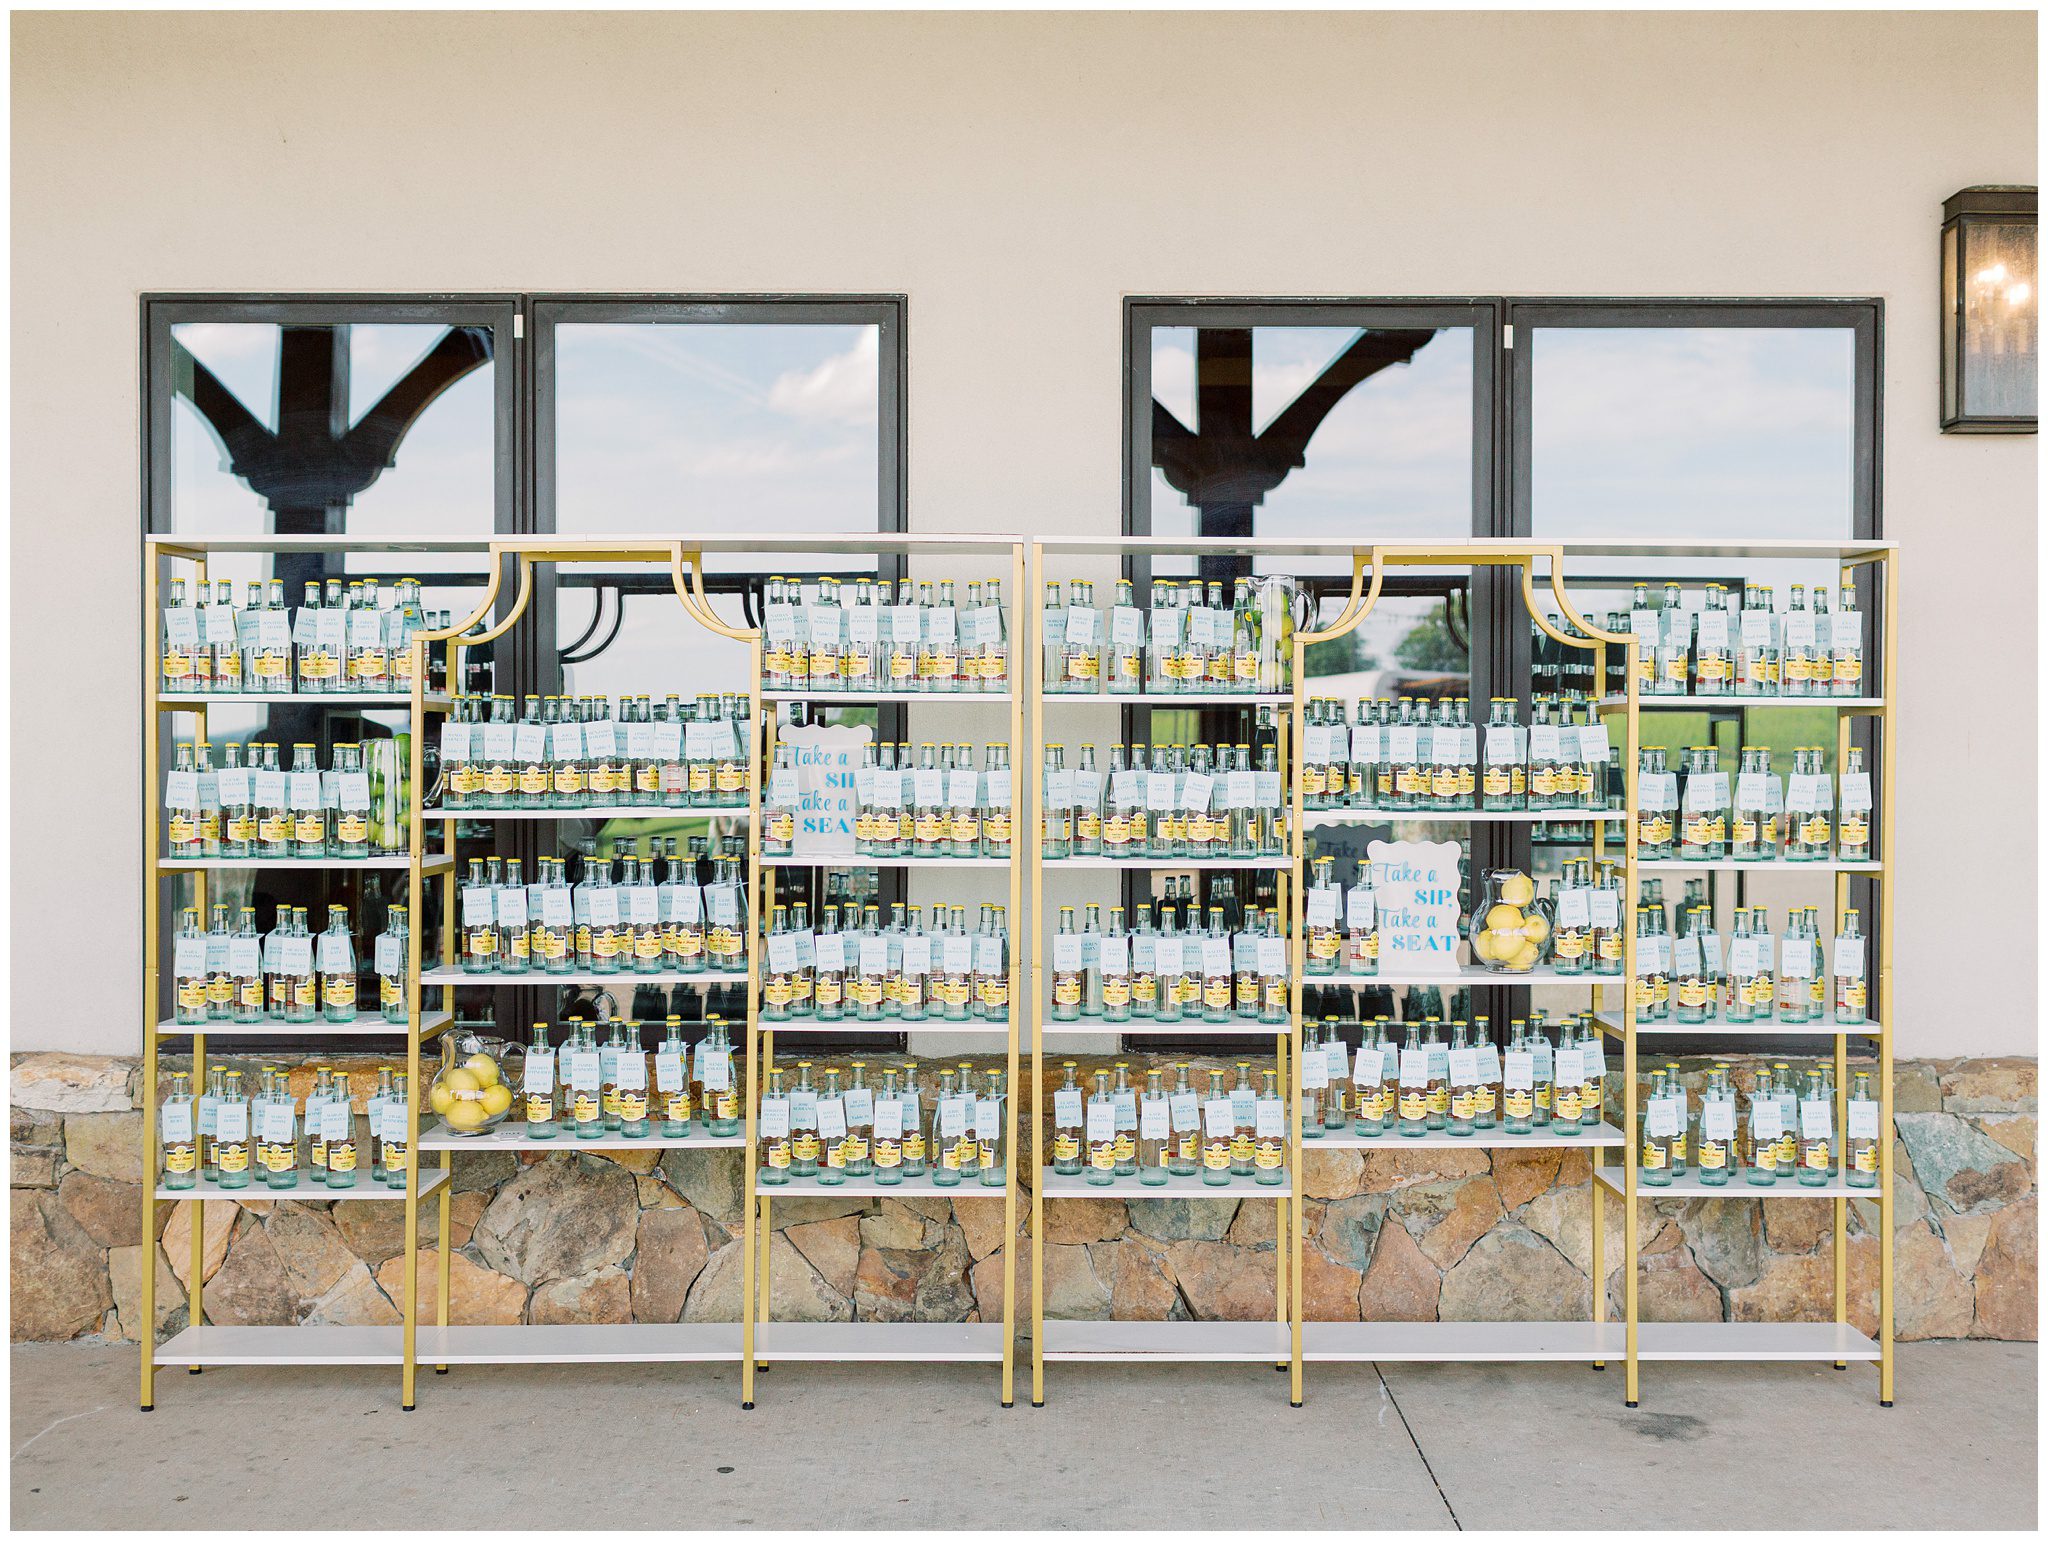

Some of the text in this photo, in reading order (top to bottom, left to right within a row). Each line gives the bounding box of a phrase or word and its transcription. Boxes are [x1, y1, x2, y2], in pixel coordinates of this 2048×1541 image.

[788, 745, 847, 767] Take a
[838, 796, 847, 812] a
[1373, 860, 1439, 883] Take a
[1414, 889, 1453, 908] SIP.
[1379, 907, 1438, 929] Take a
[1391, 934, 1457, 952] SEAT
